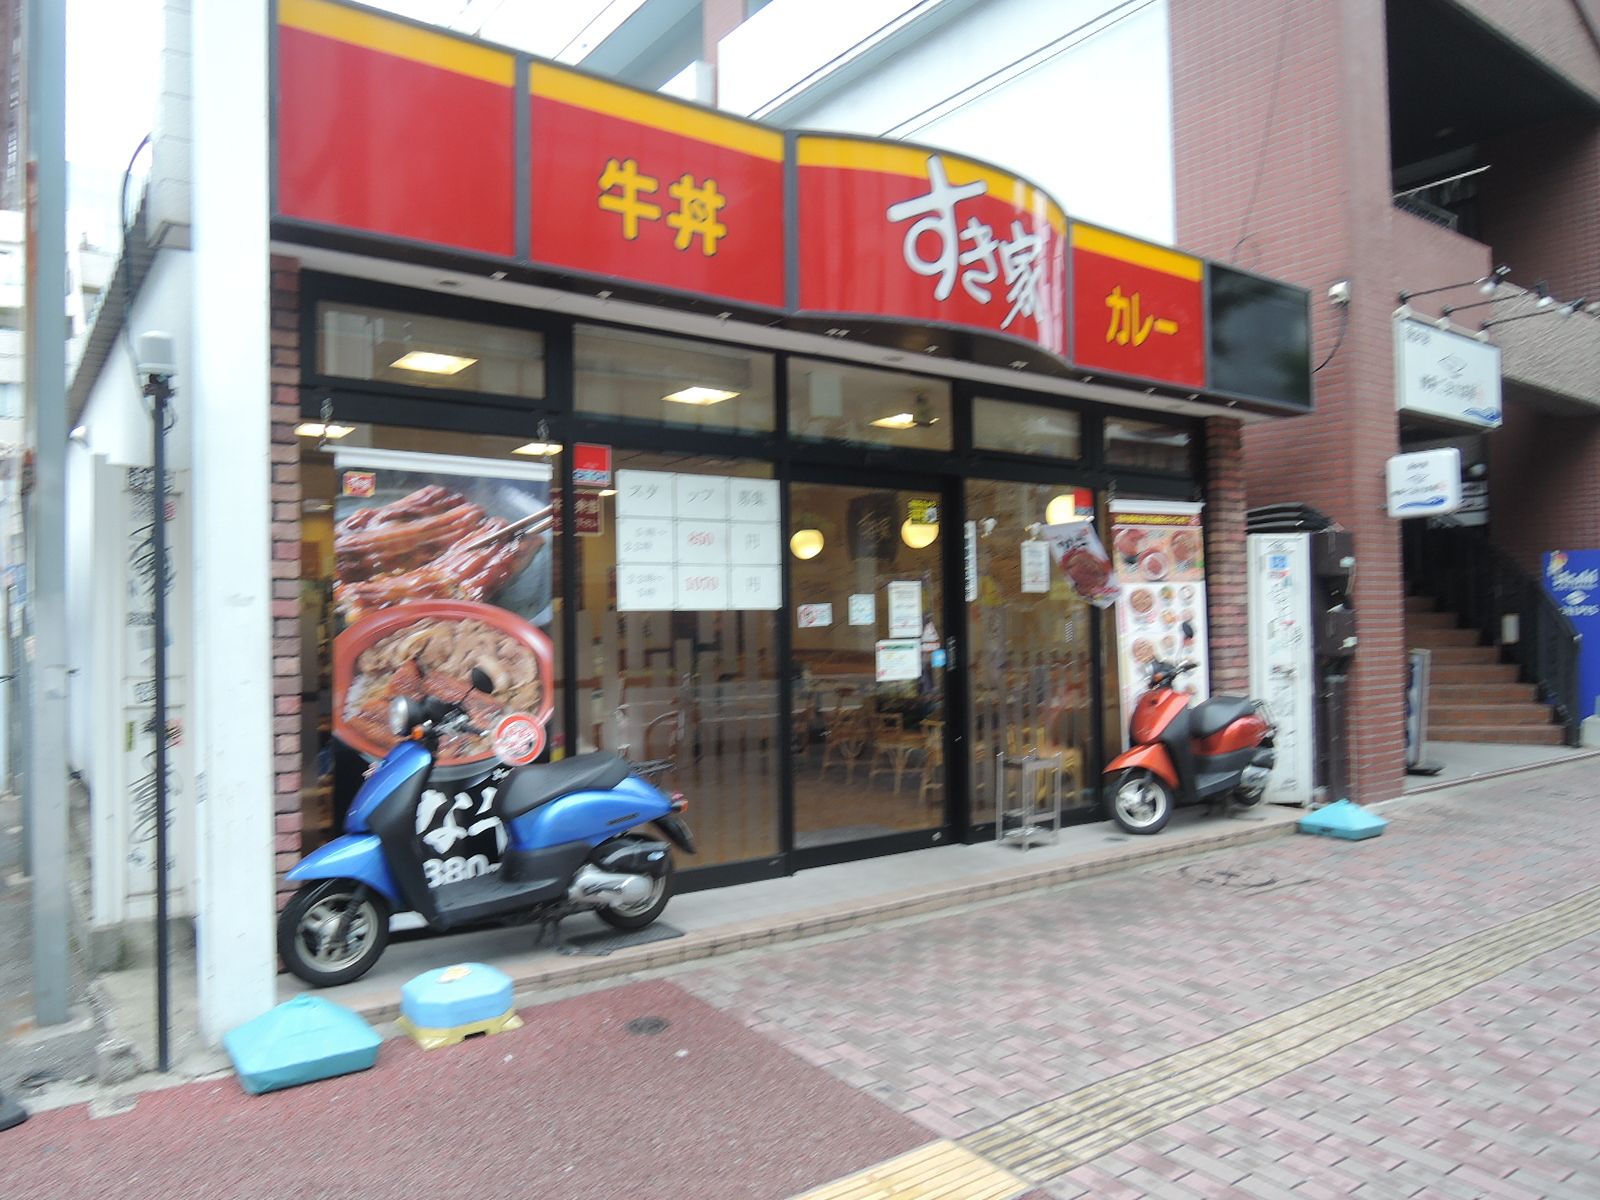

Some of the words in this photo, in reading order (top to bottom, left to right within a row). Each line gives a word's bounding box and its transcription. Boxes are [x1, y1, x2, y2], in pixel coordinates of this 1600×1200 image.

[598, 158, 728, 257] 牛丼
[886, 153, 1047, 332] すき家
[1105, 285, 1179, 348] カレー
